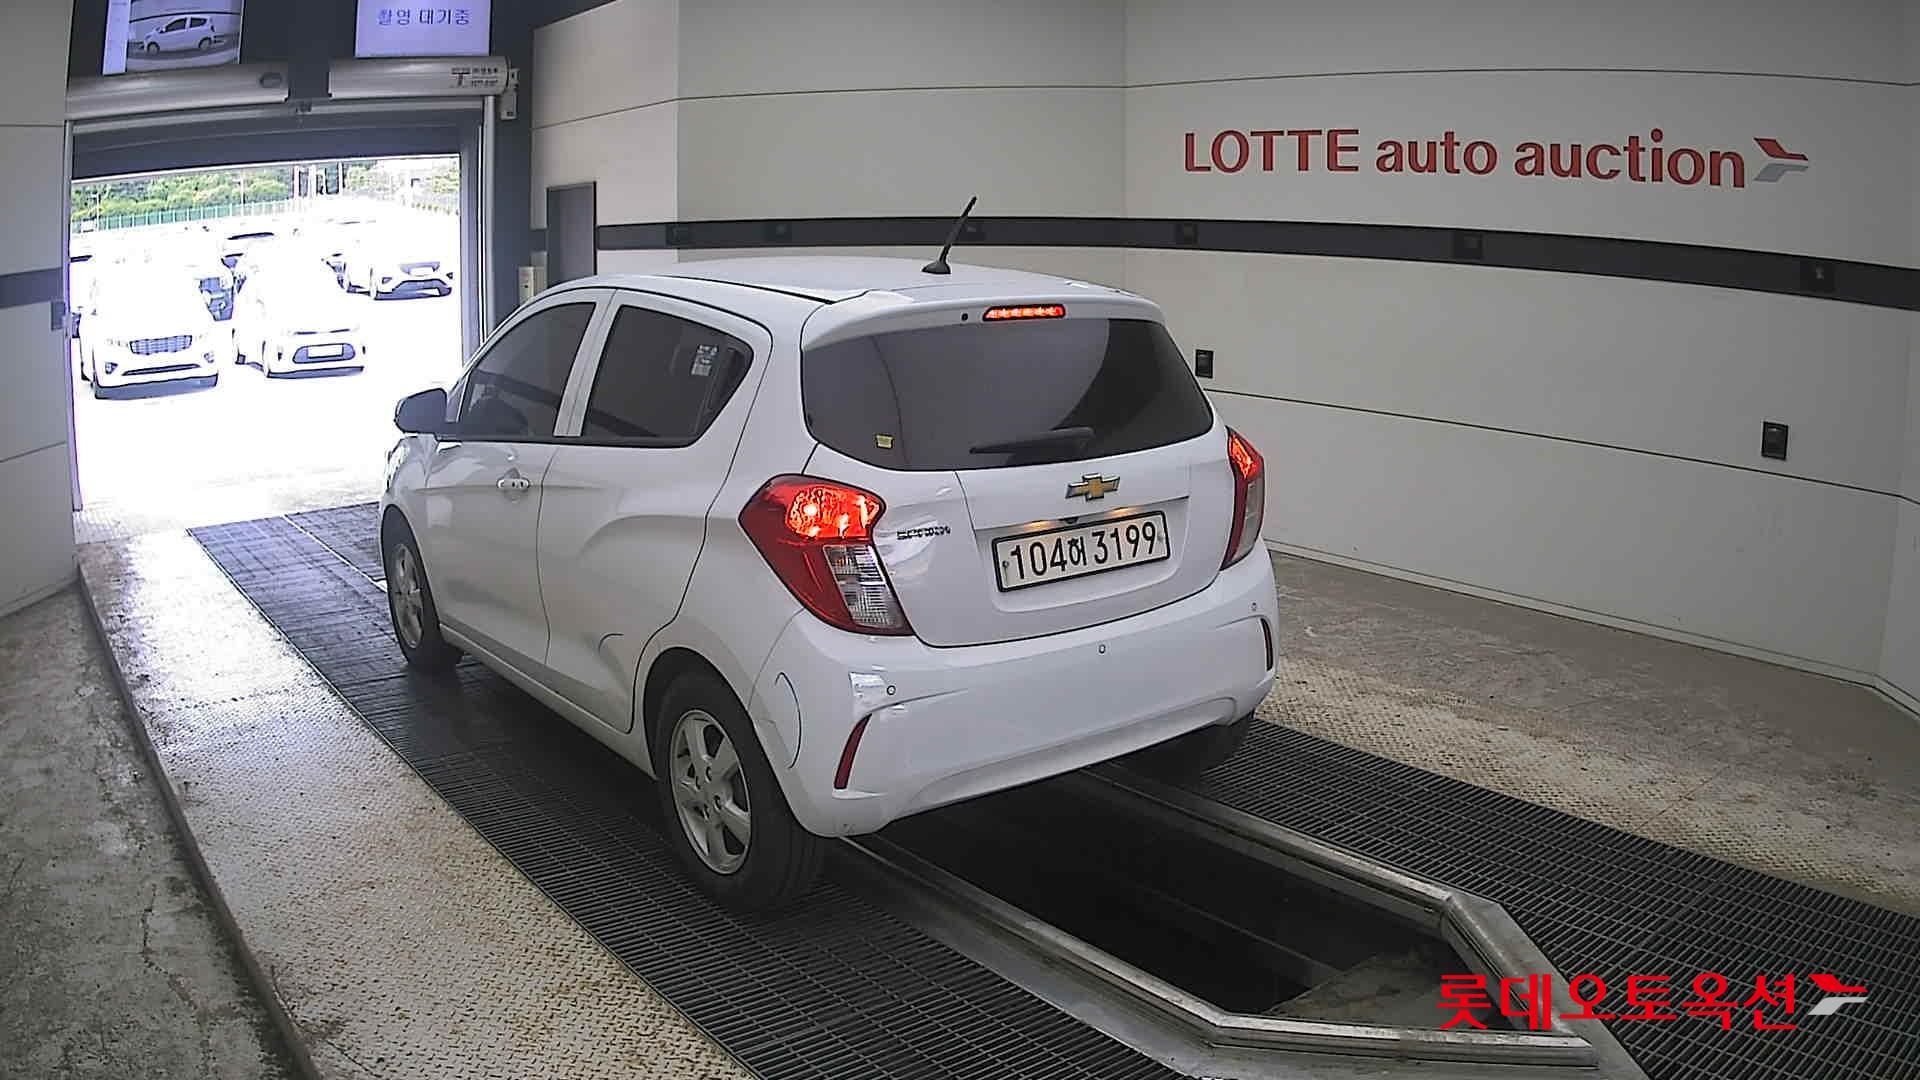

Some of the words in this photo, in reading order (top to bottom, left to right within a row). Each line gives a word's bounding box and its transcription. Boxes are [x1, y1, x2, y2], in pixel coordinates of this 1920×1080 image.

[419, 8, 470, 26] 대기중
[1184, 129, 1359, 173] LOTTE
[1376, 131, 1497, 175] auto
[1514, 128, 1745, 188] auction
[1011, 536, 1087, 579] 104허
[1092, 522, 1156, 564] 3199
